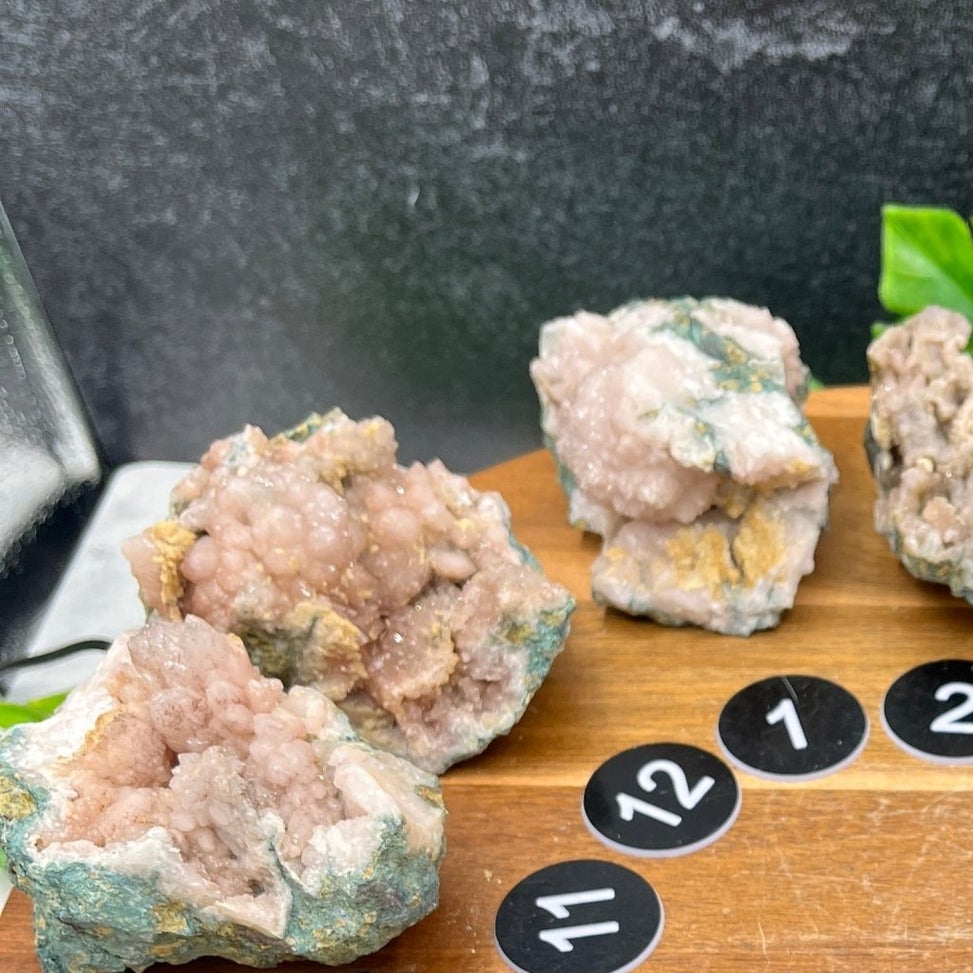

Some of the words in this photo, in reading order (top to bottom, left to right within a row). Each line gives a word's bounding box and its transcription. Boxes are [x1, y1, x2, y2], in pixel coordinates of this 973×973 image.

[766, 698, 808, 750] 1
[616, 759, 715, 827] 12
[535, 887, 620, 953] 11
